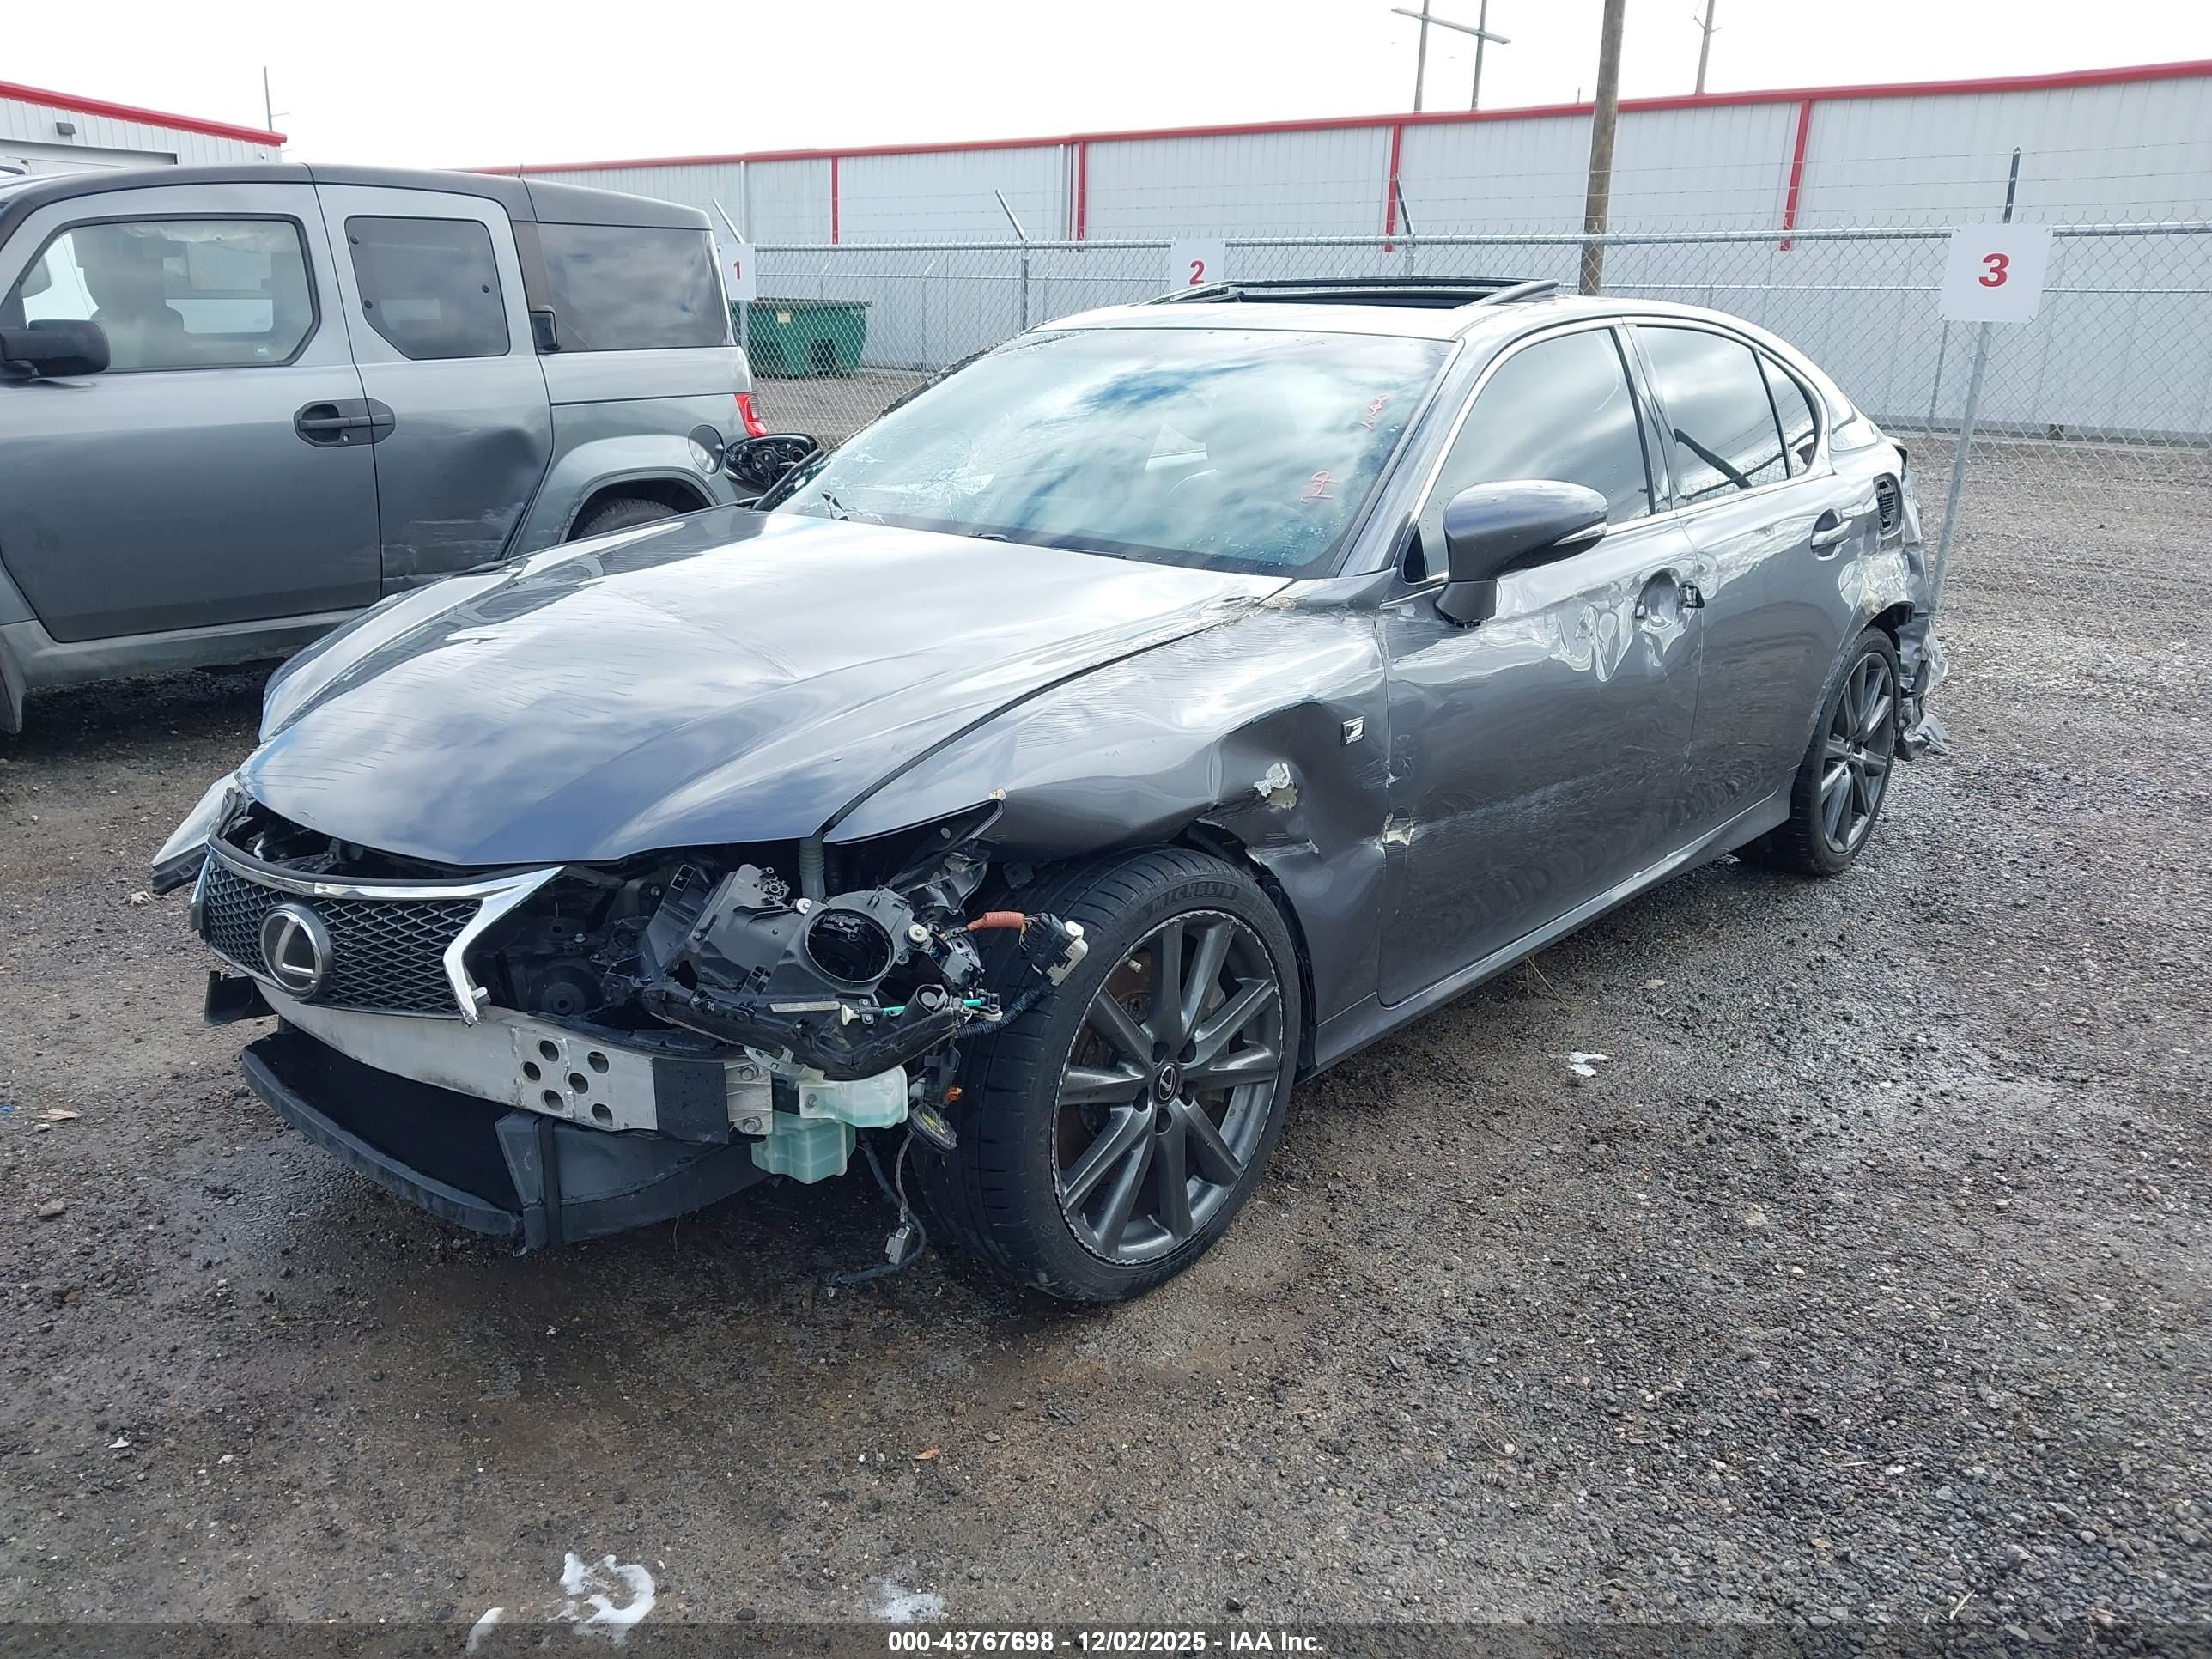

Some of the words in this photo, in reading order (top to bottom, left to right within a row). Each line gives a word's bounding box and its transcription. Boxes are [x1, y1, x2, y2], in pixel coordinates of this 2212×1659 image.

[733, 260, 741, 280] 1
[1189, 260, 1205, 285] 2
[1978, 252, 2009, 287] 3
[1152, 882, 1236, 913] MICHELIN
[707, 1001, 714, 1012] 20
